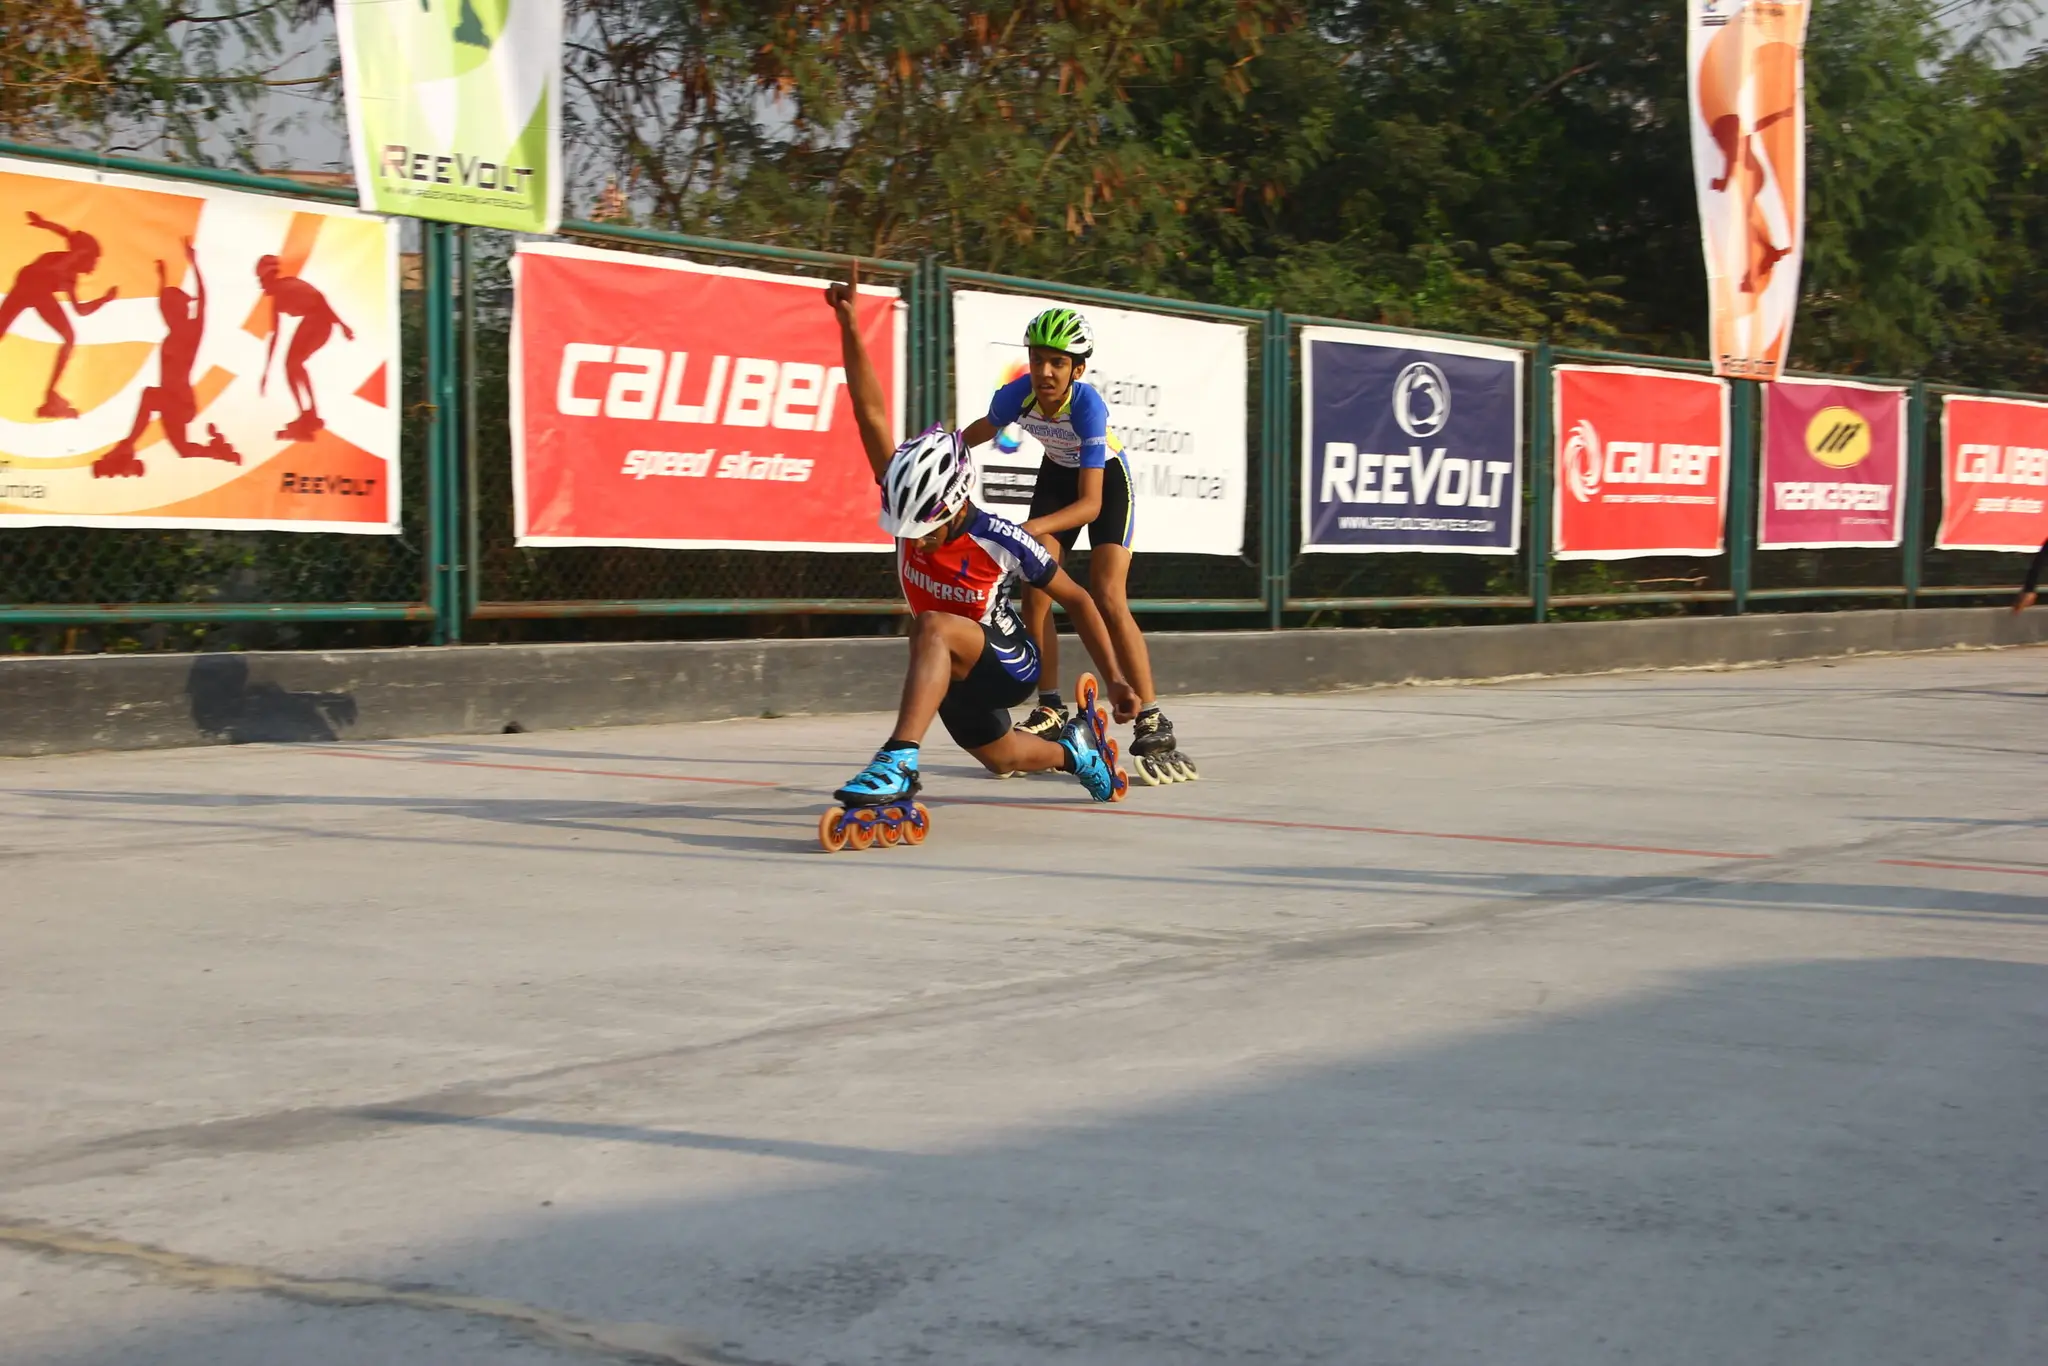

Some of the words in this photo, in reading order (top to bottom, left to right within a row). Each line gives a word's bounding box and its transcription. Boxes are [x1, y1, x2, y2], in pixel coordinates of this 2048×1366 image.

[620, 449, 716, 480] speed
[715, 450, 815, 482] skates
[903, 560, 986, 604] UNIVERSAL
